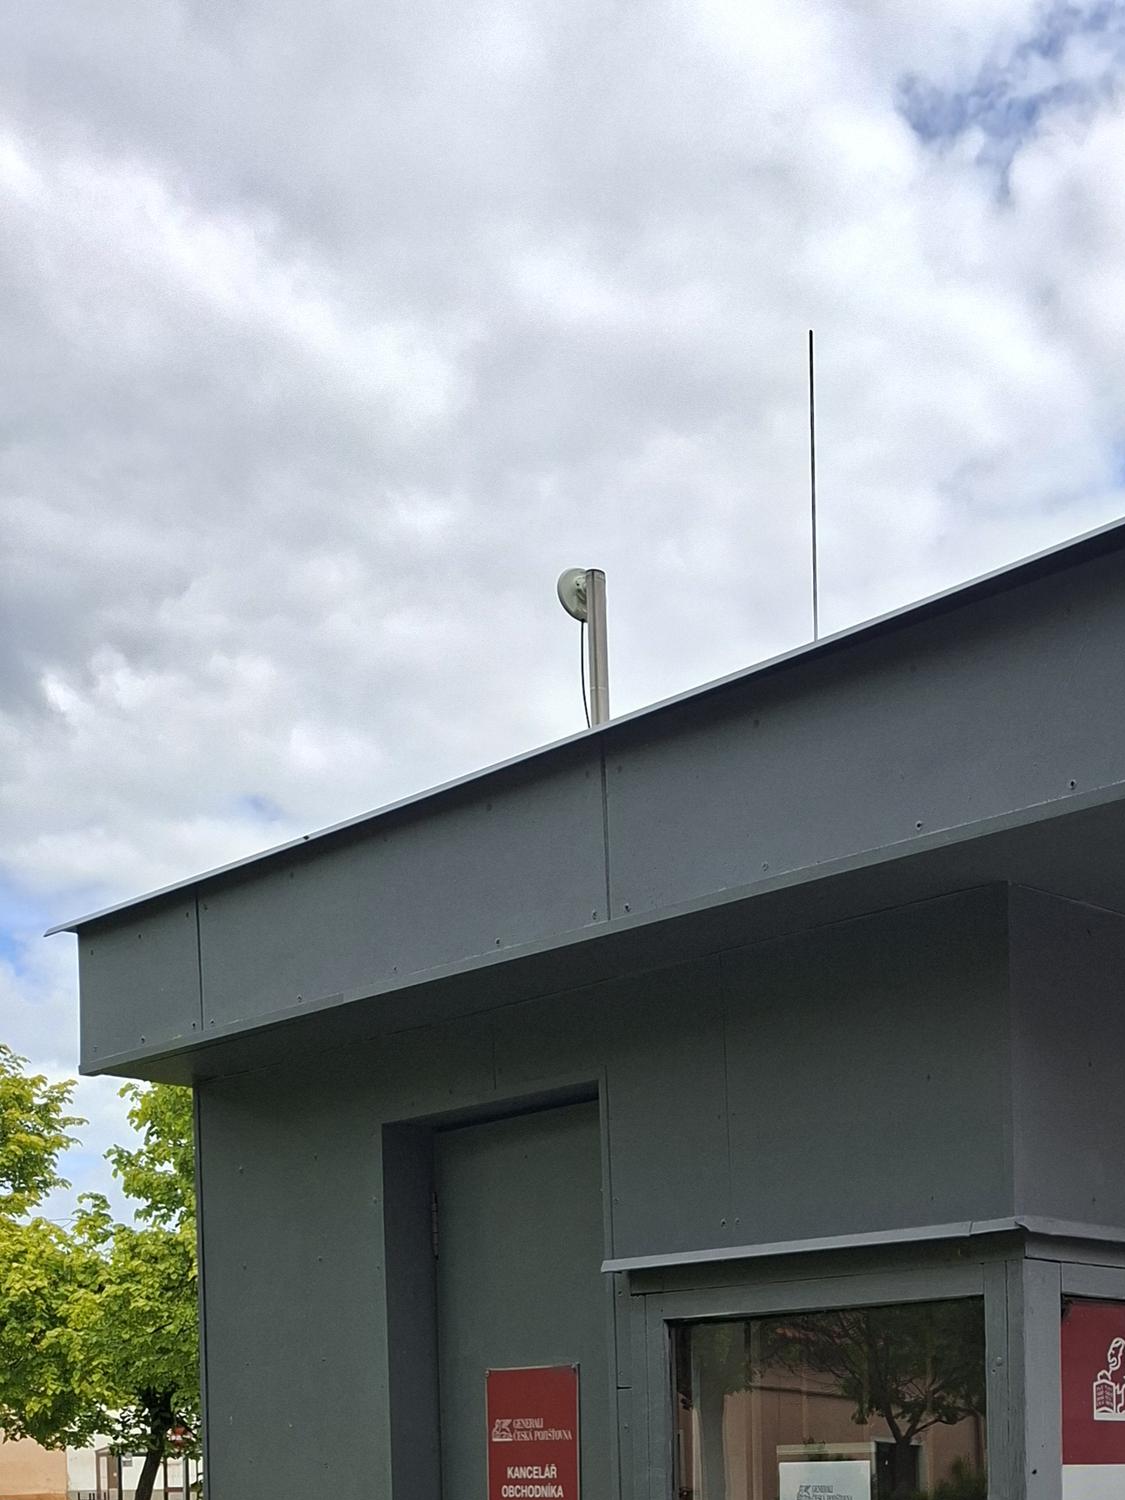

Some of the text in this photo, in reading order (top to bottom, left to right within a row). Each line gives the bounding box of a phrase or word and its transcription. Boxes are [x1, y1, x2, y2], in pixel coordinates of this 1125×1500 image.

[512, 1417, 544, 1429] GENERALI
[513, 1428, 534, 1441] ČESKÁ
[507, 1463, 558, 1479] KANCELÁŘ
[501, 1482, 564, 1498] OBCHODNÍKA
